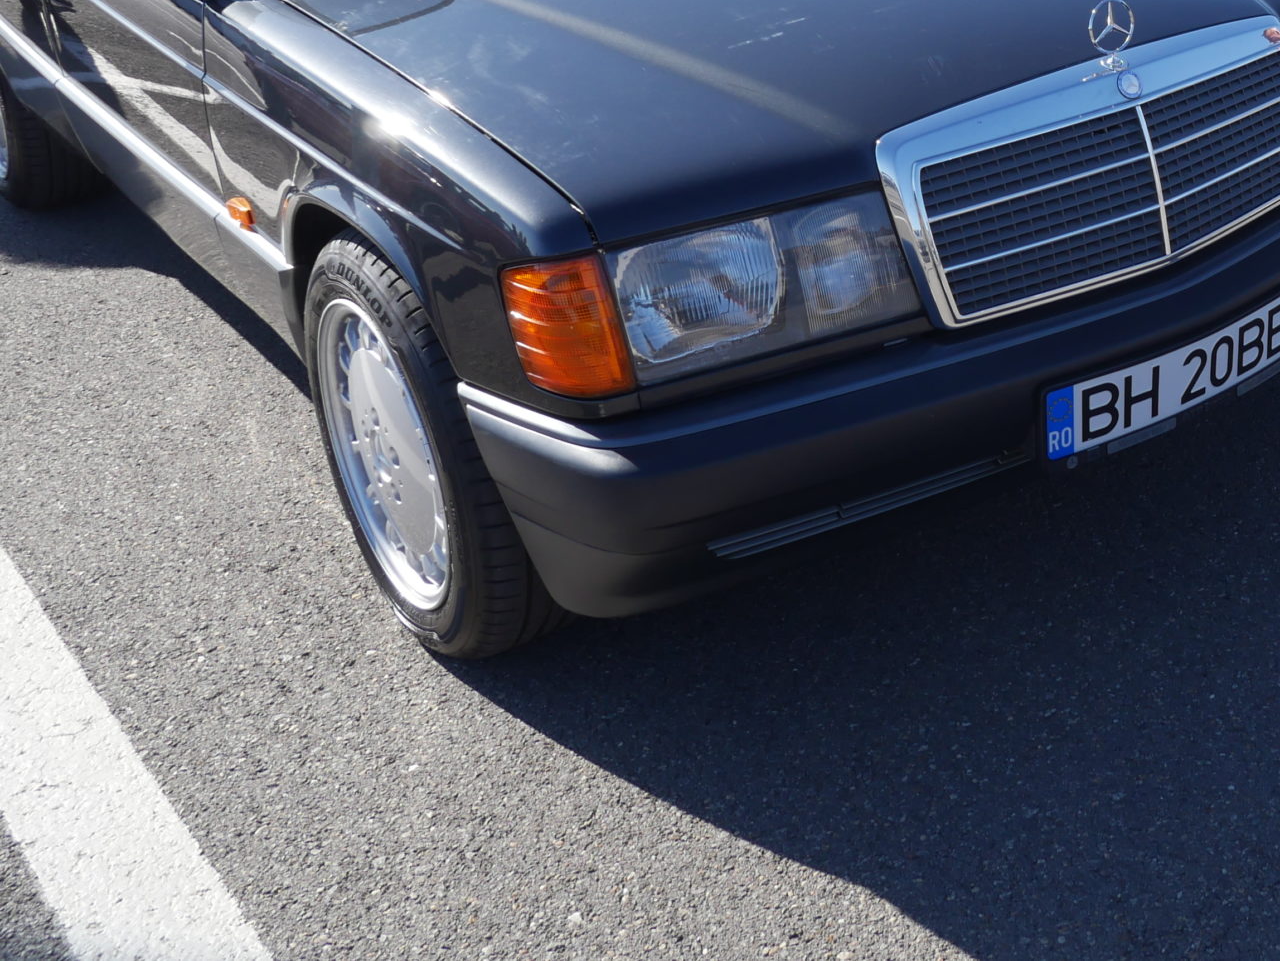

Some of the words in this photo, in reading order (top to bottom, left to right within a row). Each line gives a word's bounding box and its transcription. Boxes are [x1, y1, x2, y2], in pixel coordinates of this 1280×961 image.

[337, 262, 393, 328] DUNLOP
[1082, 366, 1160, 443] BH
[1049, 427, 1073, 453] RO
